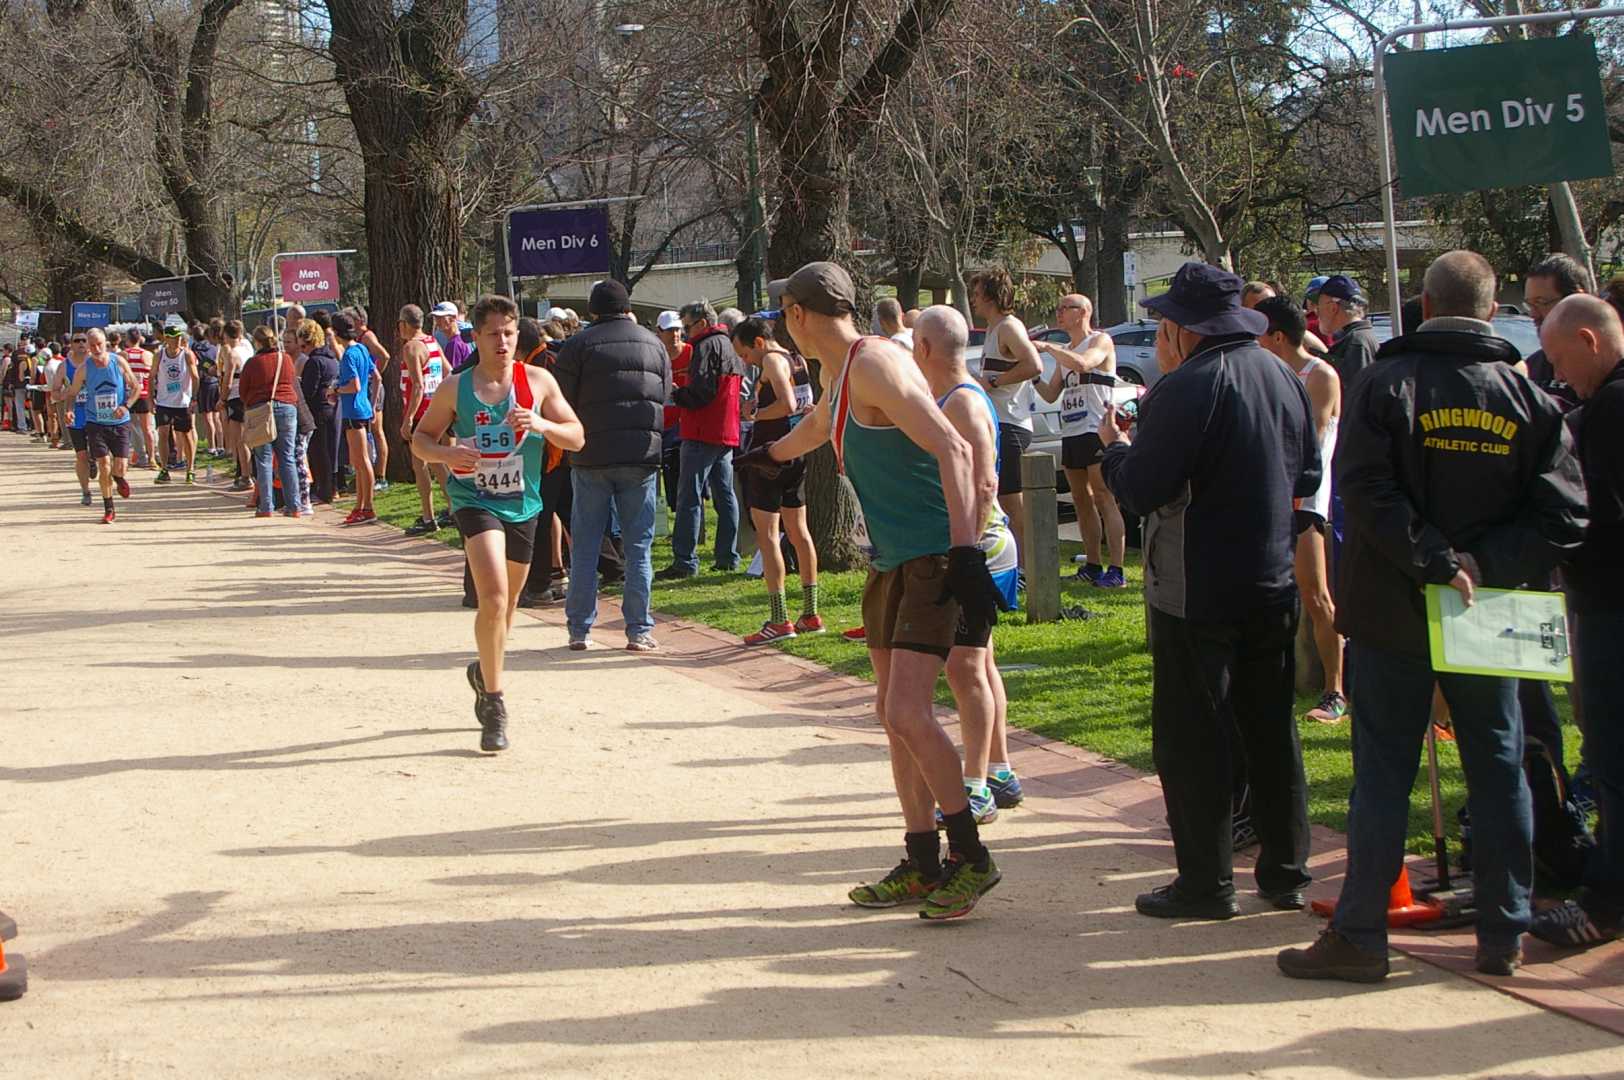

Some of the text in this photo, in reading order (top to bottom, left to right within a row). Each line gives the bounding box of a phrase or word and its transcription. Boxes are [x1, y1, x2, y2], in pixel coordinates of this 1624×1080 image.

[1416, 93, 1584, 137] Men Div 5
[521, 234, 599, 251] Men Div 6
[299, 269, 320, 279] Men
[292, 280, 329, 292] Over 40
[150, 299, 168, 307] Over
[1063, 397, 1085, 411] 1646
[1420, 408, 1517, 440] RINGWOOD
[481, 432, 510, 448] 5-6
[1424, 437, 1510, 455] ATHLETIC CLUB
[478, 470, 520, 489] 3444
